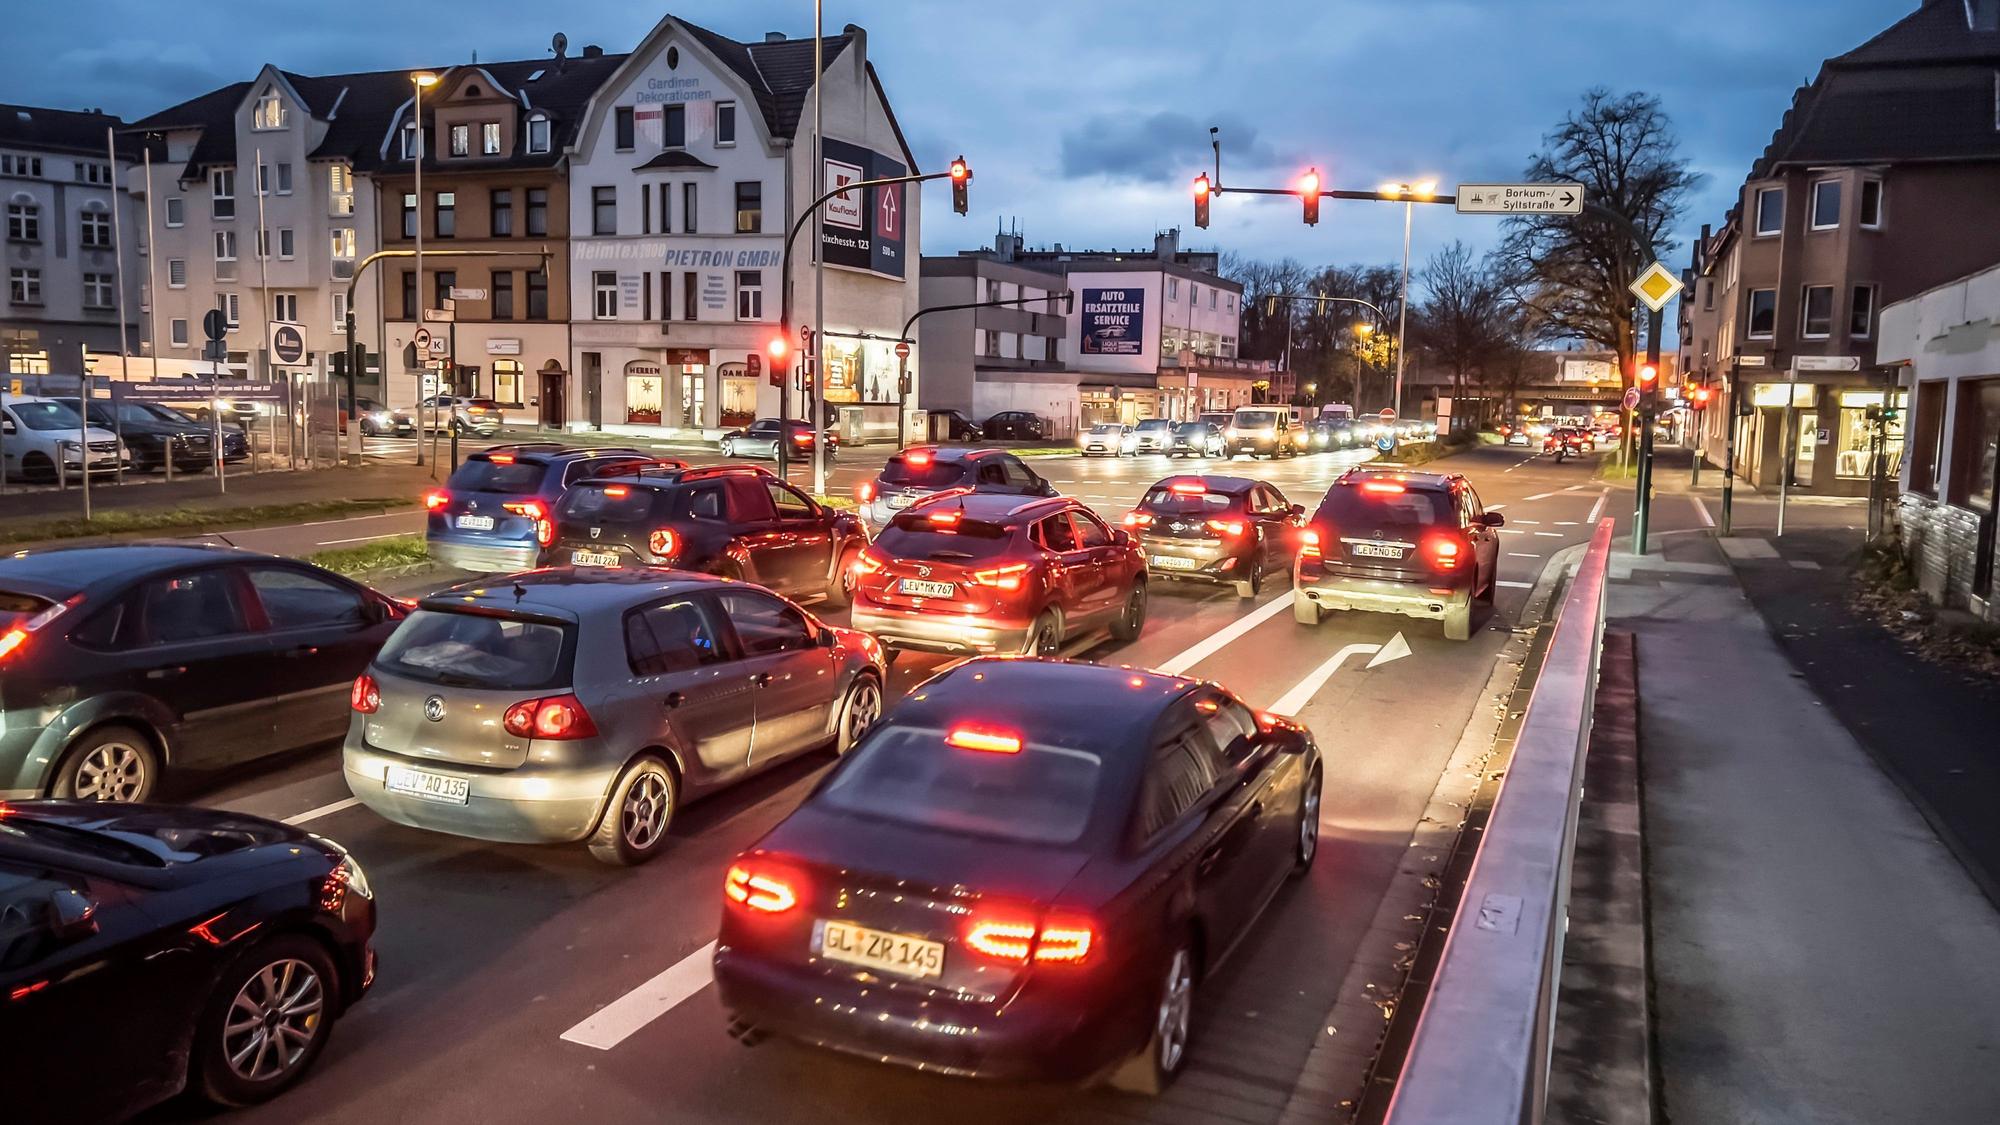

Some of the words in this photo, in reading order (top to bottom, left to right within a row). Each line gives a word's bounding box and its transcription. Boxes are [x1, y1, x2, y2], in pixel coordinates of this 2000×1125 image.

[648, 77, 699, 89] Gardinen
[636, 90, 712, 103] Dekorationen
[828, 203, 858, 216] Kaufland
[1503, 200, 1555, 211] Syltstraße
[822, 233, 857, 248] tixchesstr.
[858, 239, 870, 250] 123
[664, 250, 734, 267] PIETRON
[736, 250, 780, 267] GMBH
[1101, 291, 1125, 301] AUTO
[1085, 303, 1140, 313] ERSATZTEILE
[1094, 315, 1130, 325] SERVICE
[629, 367, 660, 375] HERREN
[1357, 547, 1374, 555] LEV
[1391, 550, 1402, 558] 56
[576, 554, 590, 563] LEV
[603, 557, 616, 566] 226
[904, 581, 921, 591] LEV
[937, 585, 953, 595] 767
[396, 772, 419, 789] LEV
[425, 775, 441, 792] AQ
[443, 779, 467, 796] 135
[826, 927, 852, 951] GL
[866, 934, 893, 961] ZR
[899, 942, 940, 969] 145
